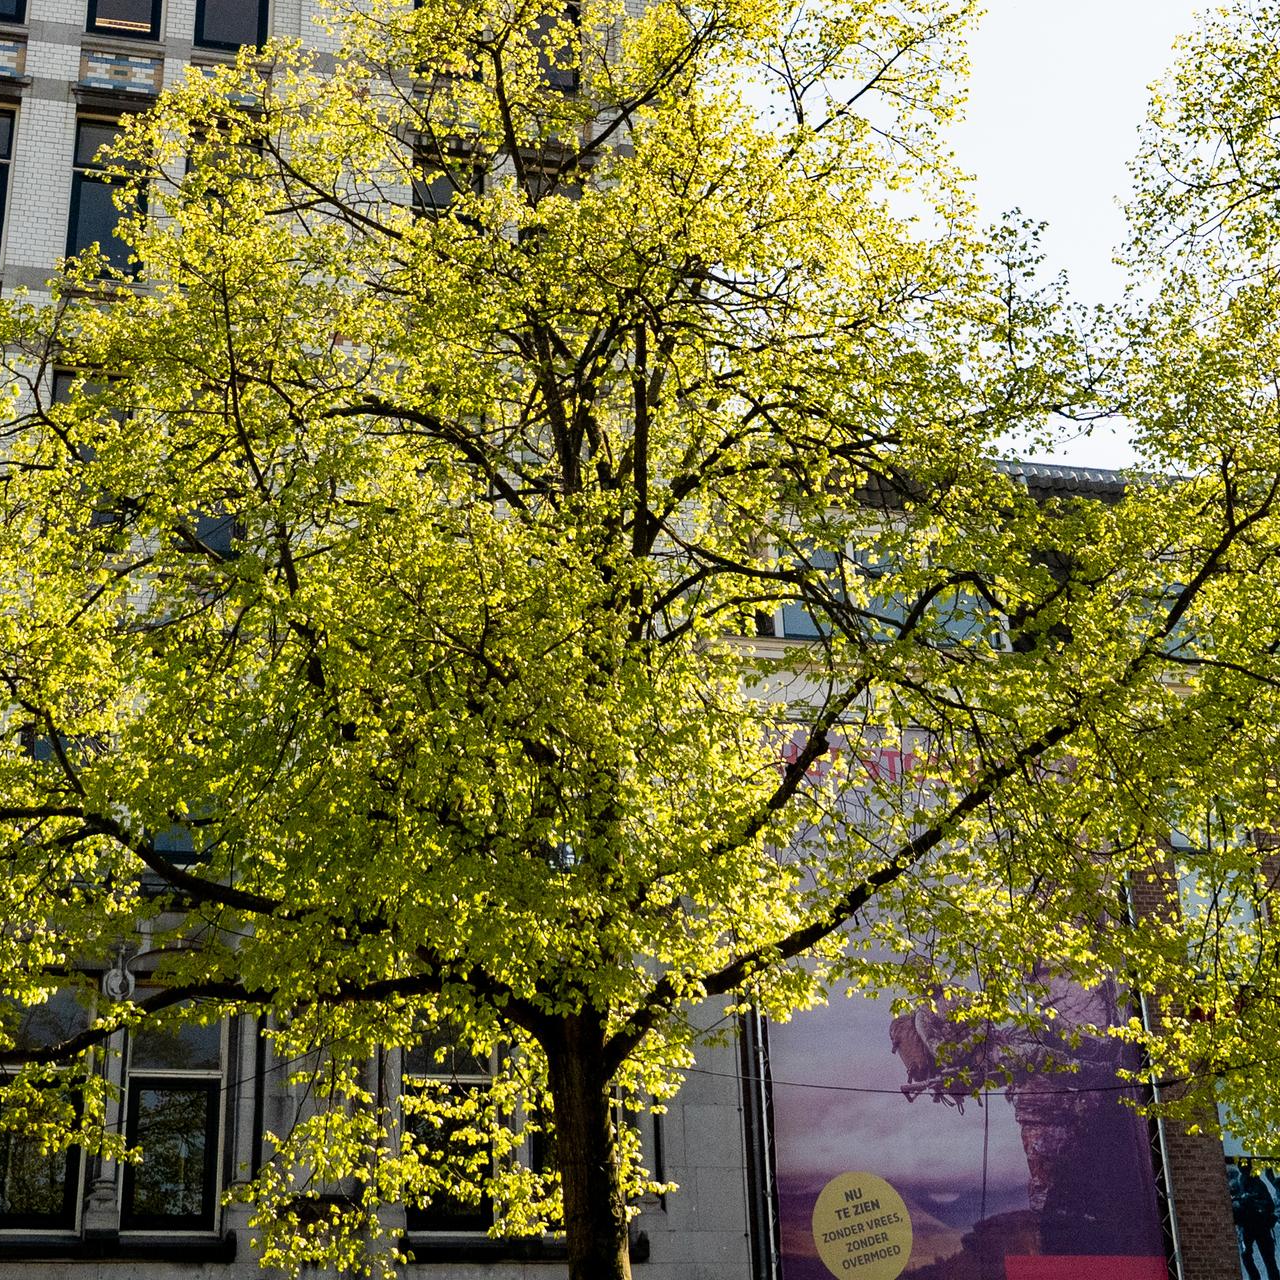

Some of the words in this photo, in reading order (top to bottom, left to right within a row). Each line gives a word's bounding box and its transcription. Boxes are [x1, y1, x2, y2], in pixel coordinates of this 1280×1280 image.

[844, 1188, 862, 1202] NU
[834, 1207, 851, 1220] TE
[852, 1199, 880, 1216] ZIEN
[822, 1223, 864, 1243] ZONDER
[865, 1212, 903, 1230] VREES,
[846, 1232, 888, 1252] ZONDER
[842, 1245, 900, 1269] OVERMOED
